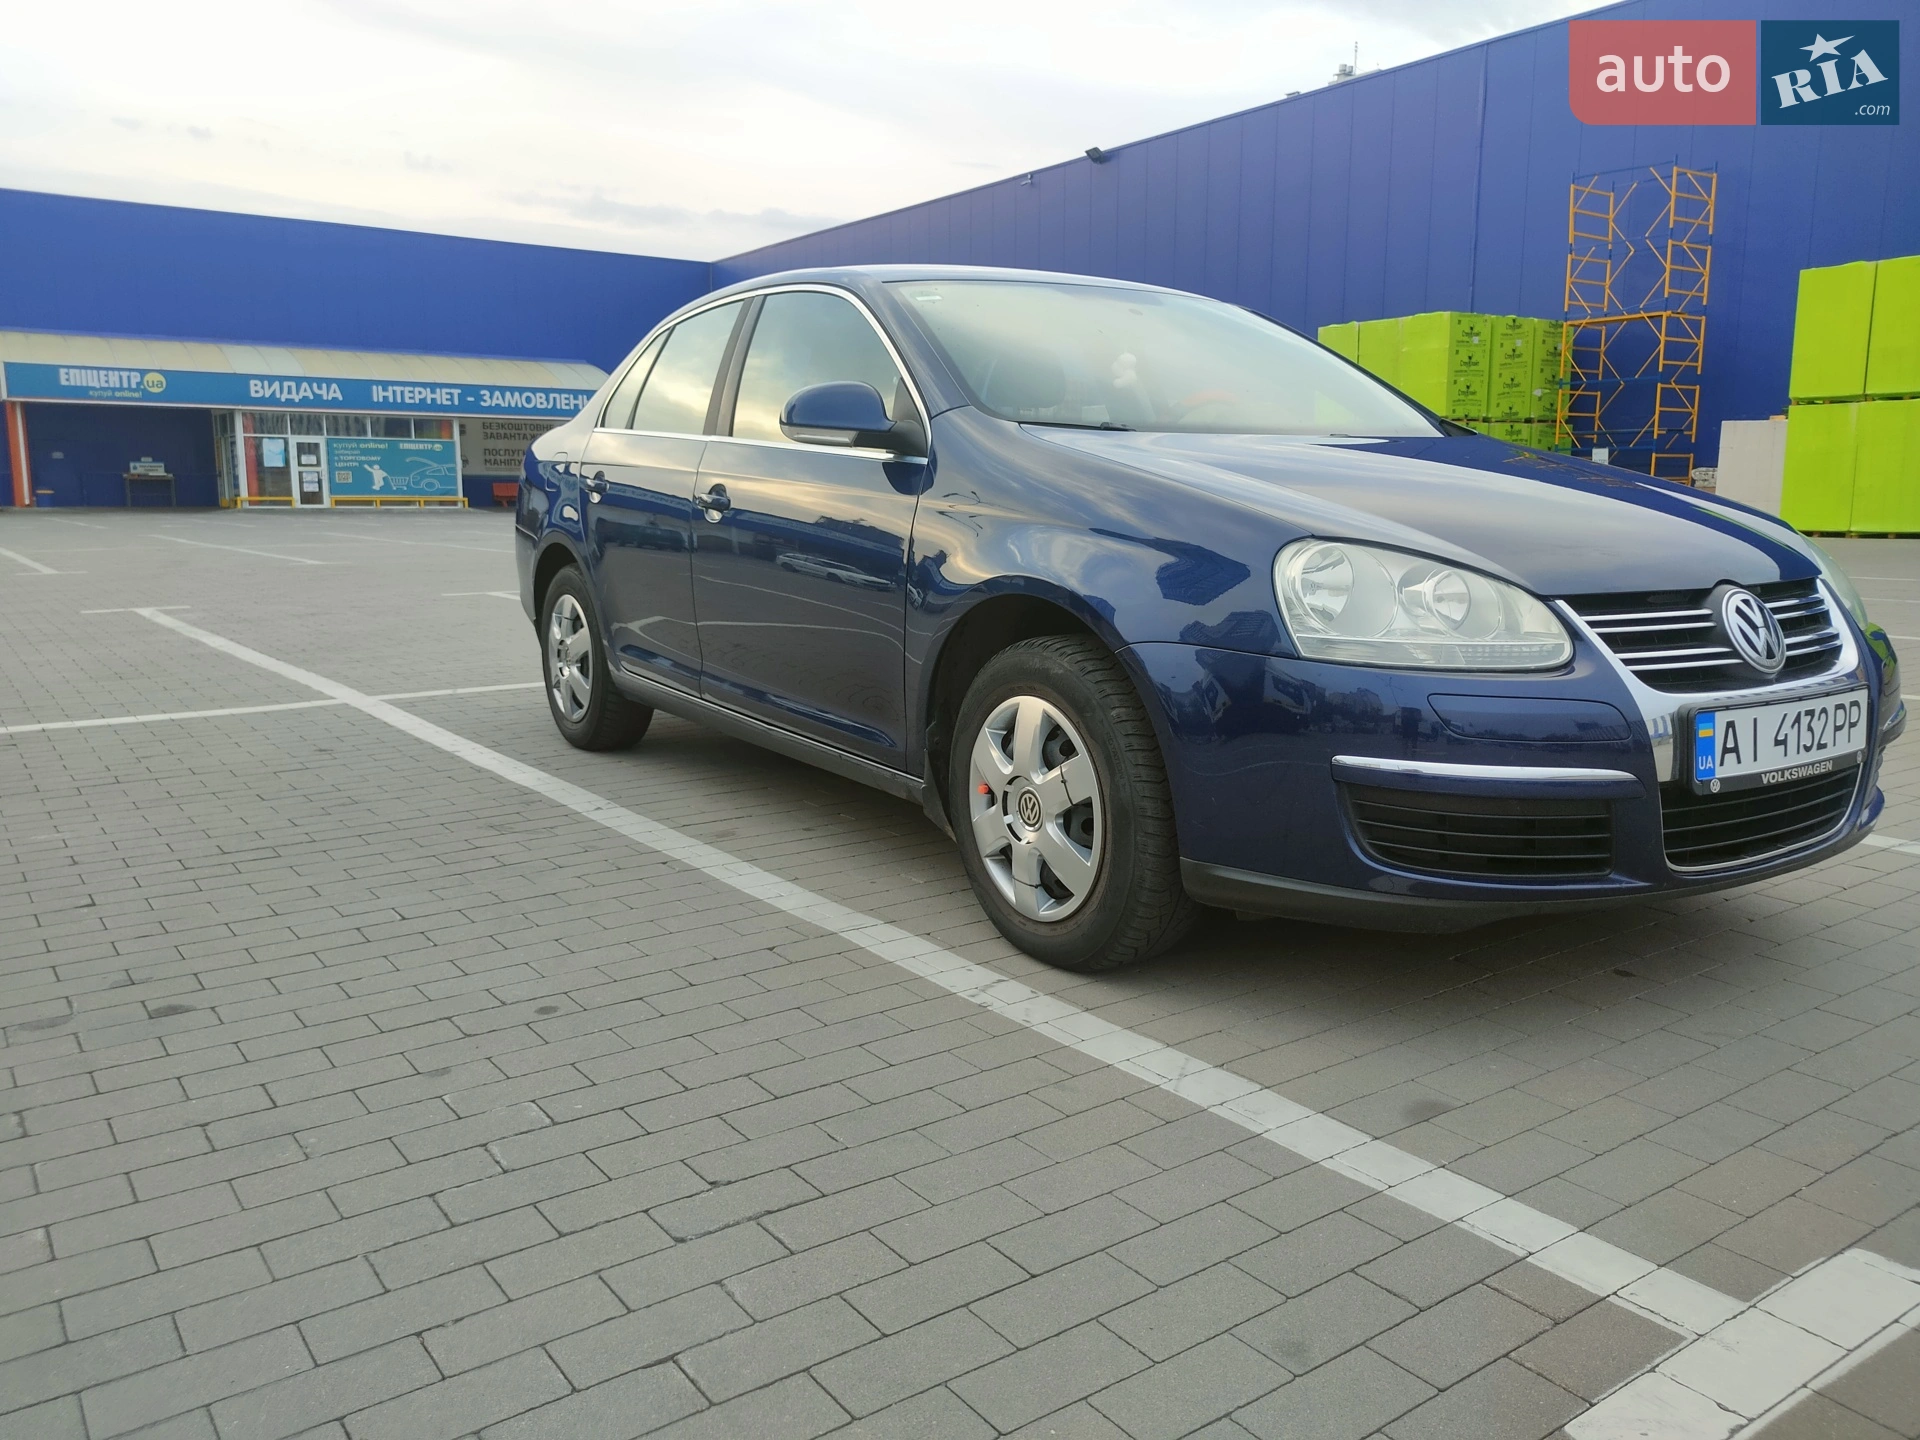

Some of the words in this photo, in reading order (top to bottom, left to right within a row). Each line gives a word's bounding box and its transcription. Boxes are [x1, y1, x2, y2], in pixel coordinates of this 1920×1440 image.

[114, 389, 143, 399] online!
[249, 379, 344, 403] ВИДАЧА
[372, 384, 462, 406] ІНТЕРНЕТ
[359, 442, 388, 450] online!
[1718, 716, 1759, 768] AI
[1773, 706, 1828, 758] 4132
[1832, 699, 1862, 748] PP
[1698, 755, 1714, 770] UA
[1760, 760, 1833, 785] VOLKSWAGEN
